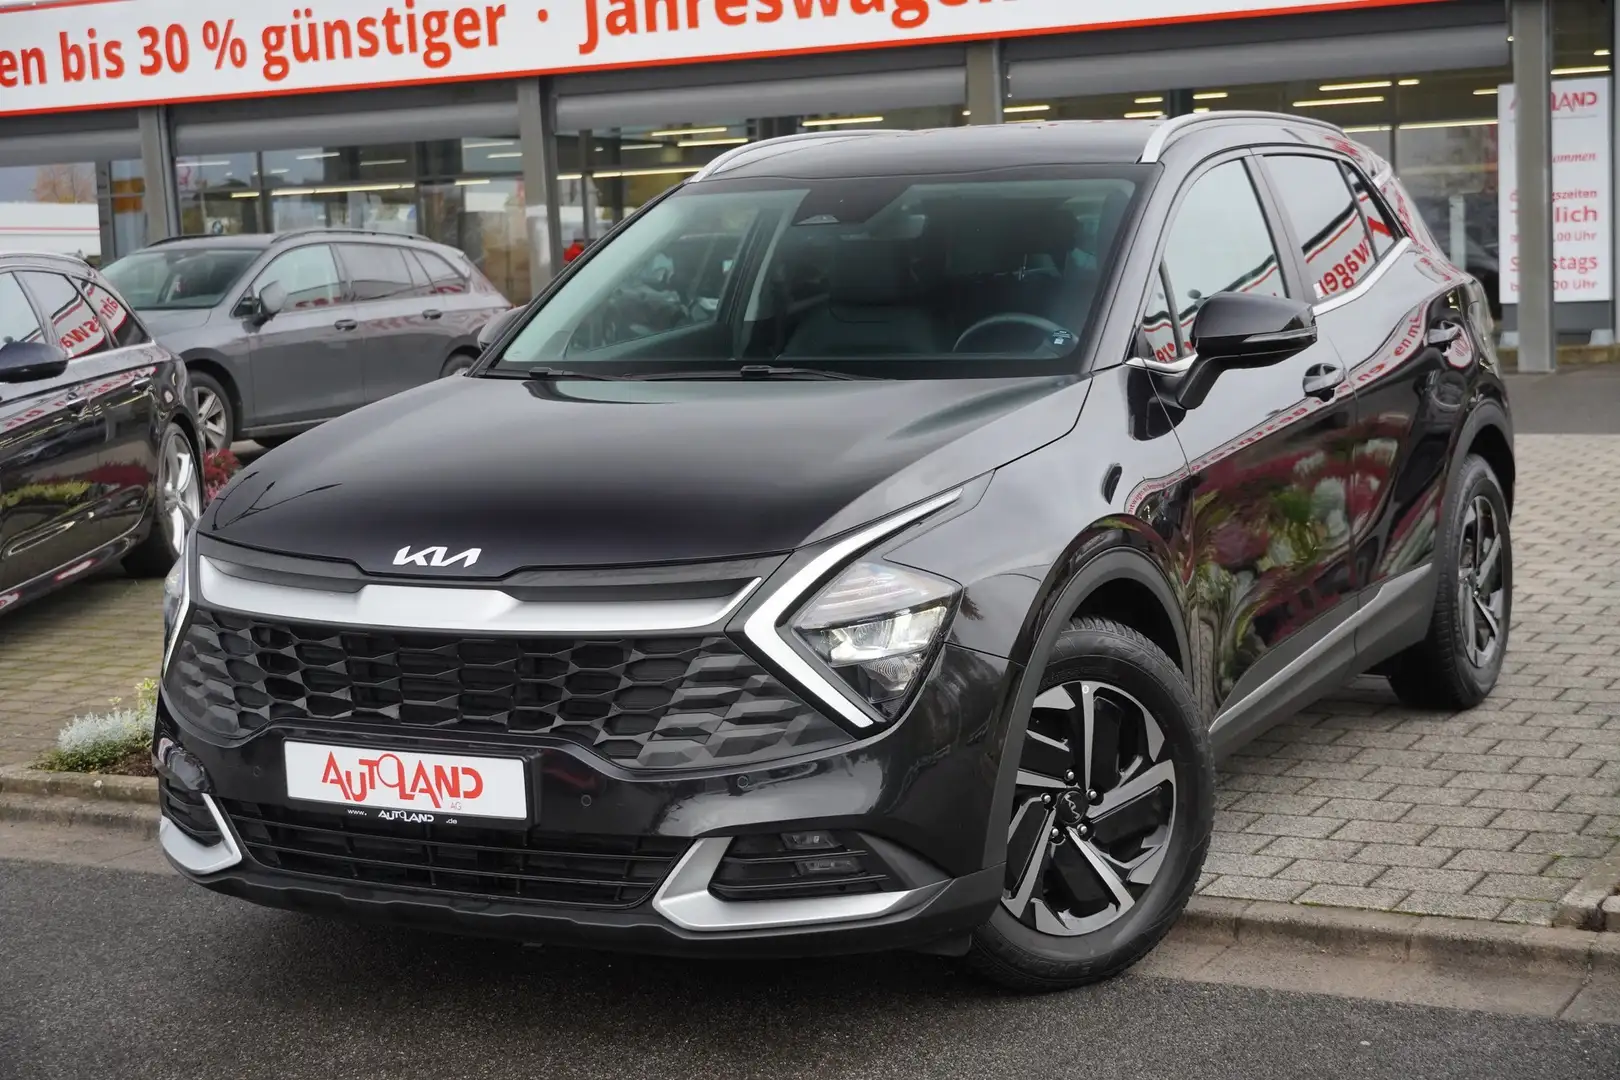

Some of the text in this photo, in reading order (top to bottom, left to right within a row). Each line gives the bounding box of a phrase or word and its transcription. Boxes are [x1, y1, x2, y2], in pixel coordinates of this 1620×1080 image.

[60, 28, 125, 83] bis
[138, 23, 189, 77] 30
[202, 20, 248, 70] %
[262, 0, 506, 82] günstiger
[578, 0, 993, 56] Jahresg
[1574, 229, 1598, 242] Uhr
[1572, 279, 1599, 290] Uhr
[392, 545, 482, 568] KIA
[321, 751, 484, 808] AUTOLAND
[347, 808, 368, 816] www.
[378, 809, 435, 824] AUTOLAND
